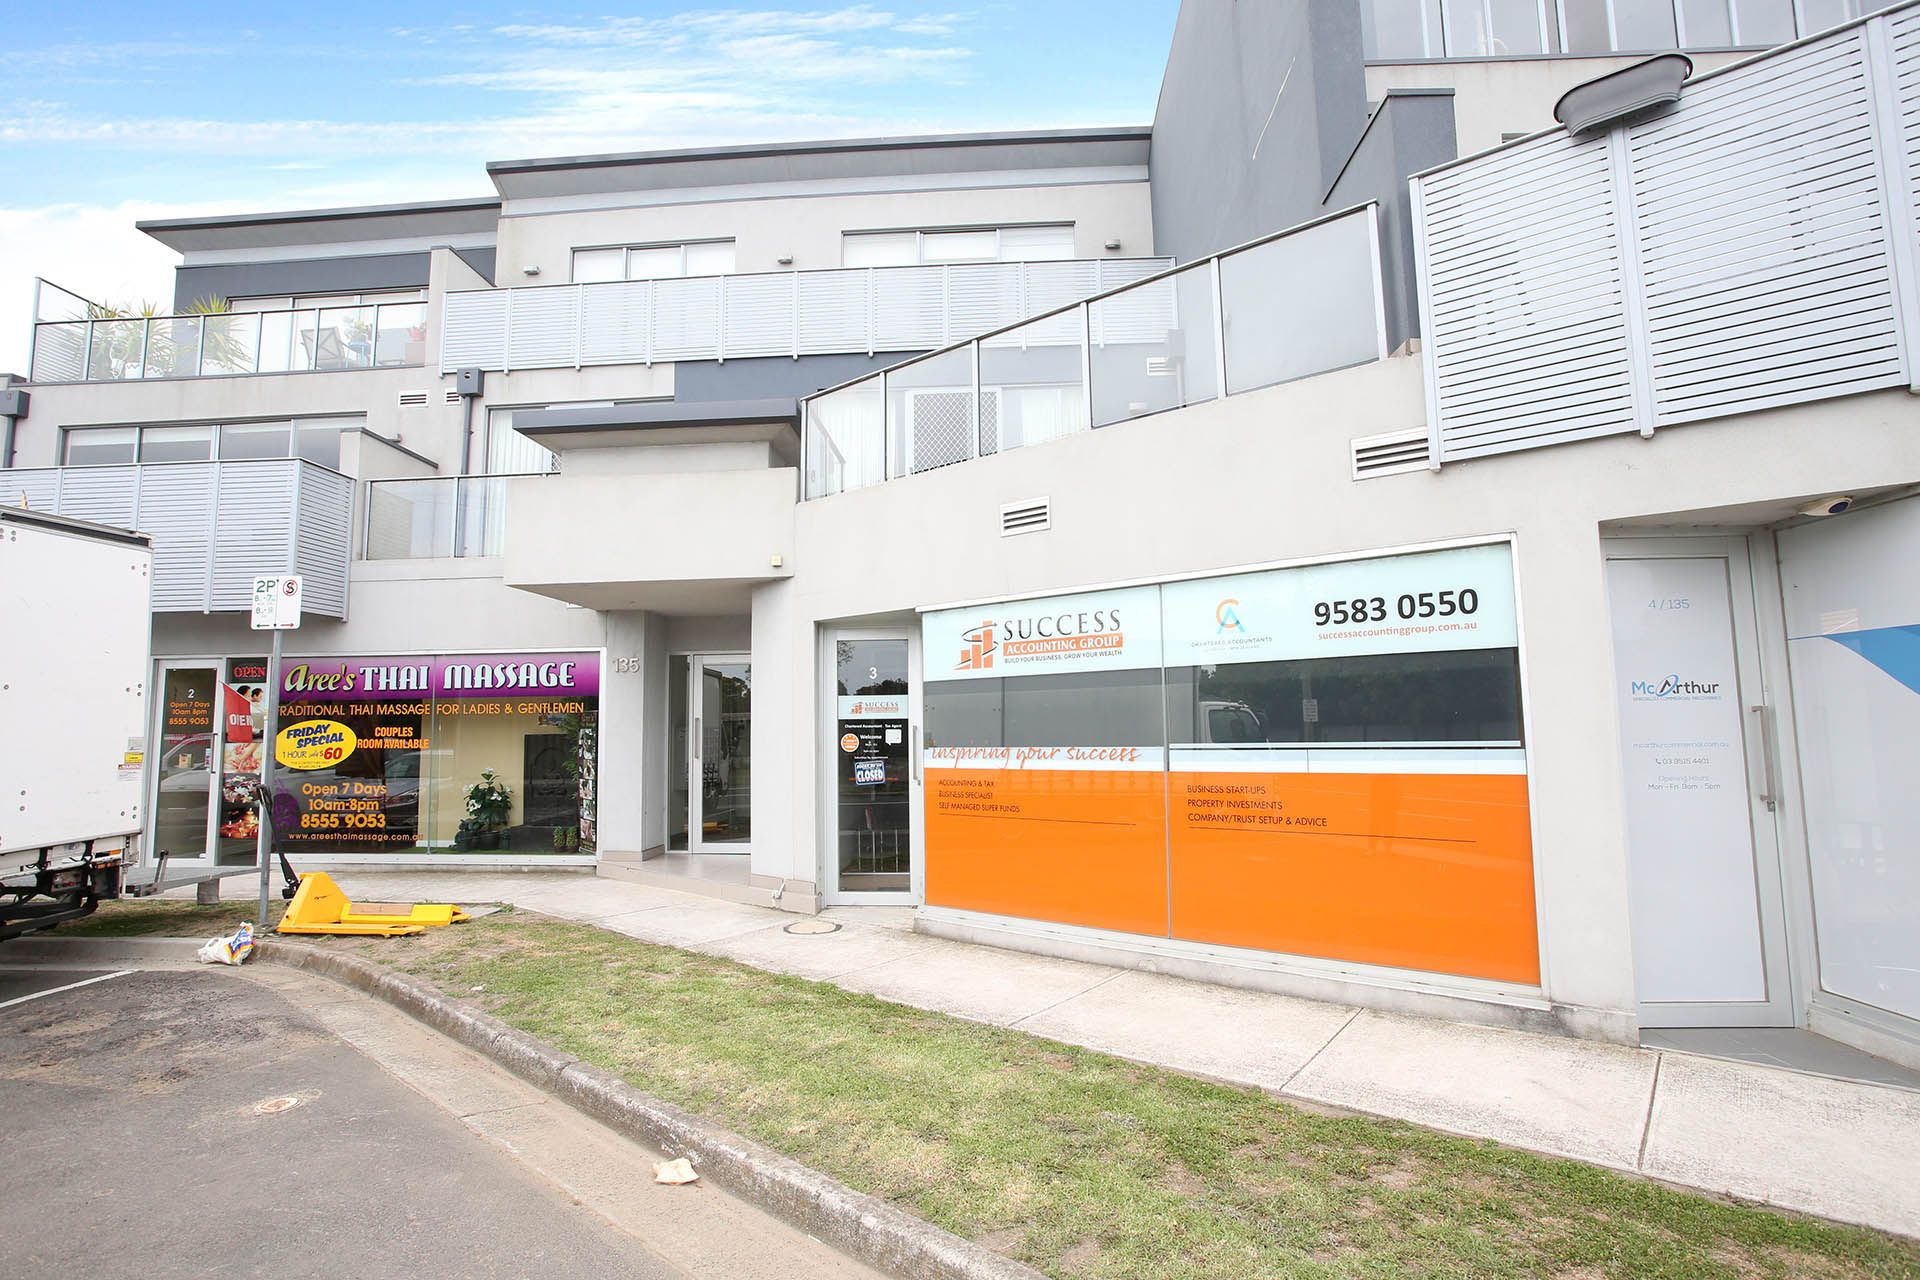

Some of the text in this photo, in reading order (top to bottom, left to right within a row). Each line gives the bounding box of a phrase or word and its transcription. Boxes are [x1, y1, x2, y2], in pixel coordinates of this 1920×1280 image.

[256, 580, 275, 593] 2P
[1314, 588, 1478, 626] 9583 0550
[1648, 599, 1656, 608] 4
[1668, 599, 1690, 609] 135
[1004, 609, 1121, 641] SUCCESS
[1318, 622, 1477, 640] successaccountinggroup.com.au
[1006, 636, 1120, 655] ACCOUNTING GROUP
[612, 657, 640, 673] 135
[233, 666, 265, 678] OPEN
[360, 665, 429, 691] THAI
[443, 662, 575, 689] MASSAGE
[869, 666, 878, 680] 3
[1631, 677, 1719, 696] McArthur
[187, 688, 195, 699] 2
[350, 704, 373, 715] THAI
[377, 704, 430, 715] MASSAGE
[436, 704, 459, 715] FOR
[463, 703, 500, 714] LADIES
[504, 703, 513, 713] &
[517, 702, 584, 714] GENTLEMEN
[286, 724, 331, 739] FRIDAY
[374, 726, 414, 738] COUPLES
[296, 732, 344, 749] SPECIAL
[357, 738, 430, 749] ROOM AVAILABLE
[287, 750, 307, 759] HOUR
[931, 742, 1143, 769] inspiring your success
[857, 769, 883, 782] CLOSED
[302, 782, 387, 796] Open 7 Days
[938, 791, 993, 800] BUSINESS SPECIALIST
[1187, 784, 1266, 795] BUSINESS START-UPS
[309, 798, 379, 813] 10am-8pm
[951, 803, 980, 811] MANAGED
[981, 804, 999, 812] SUPER
[1000, 805, 1020, 813] FUNDS
[1187, 799, 1283, 810] PROPERTY INVESTMENTS
[301, 813, 386, 828] 8555 9053
[1187, 813, 1327, 826] COMPANY/TRUST SETUP & ADVICE
